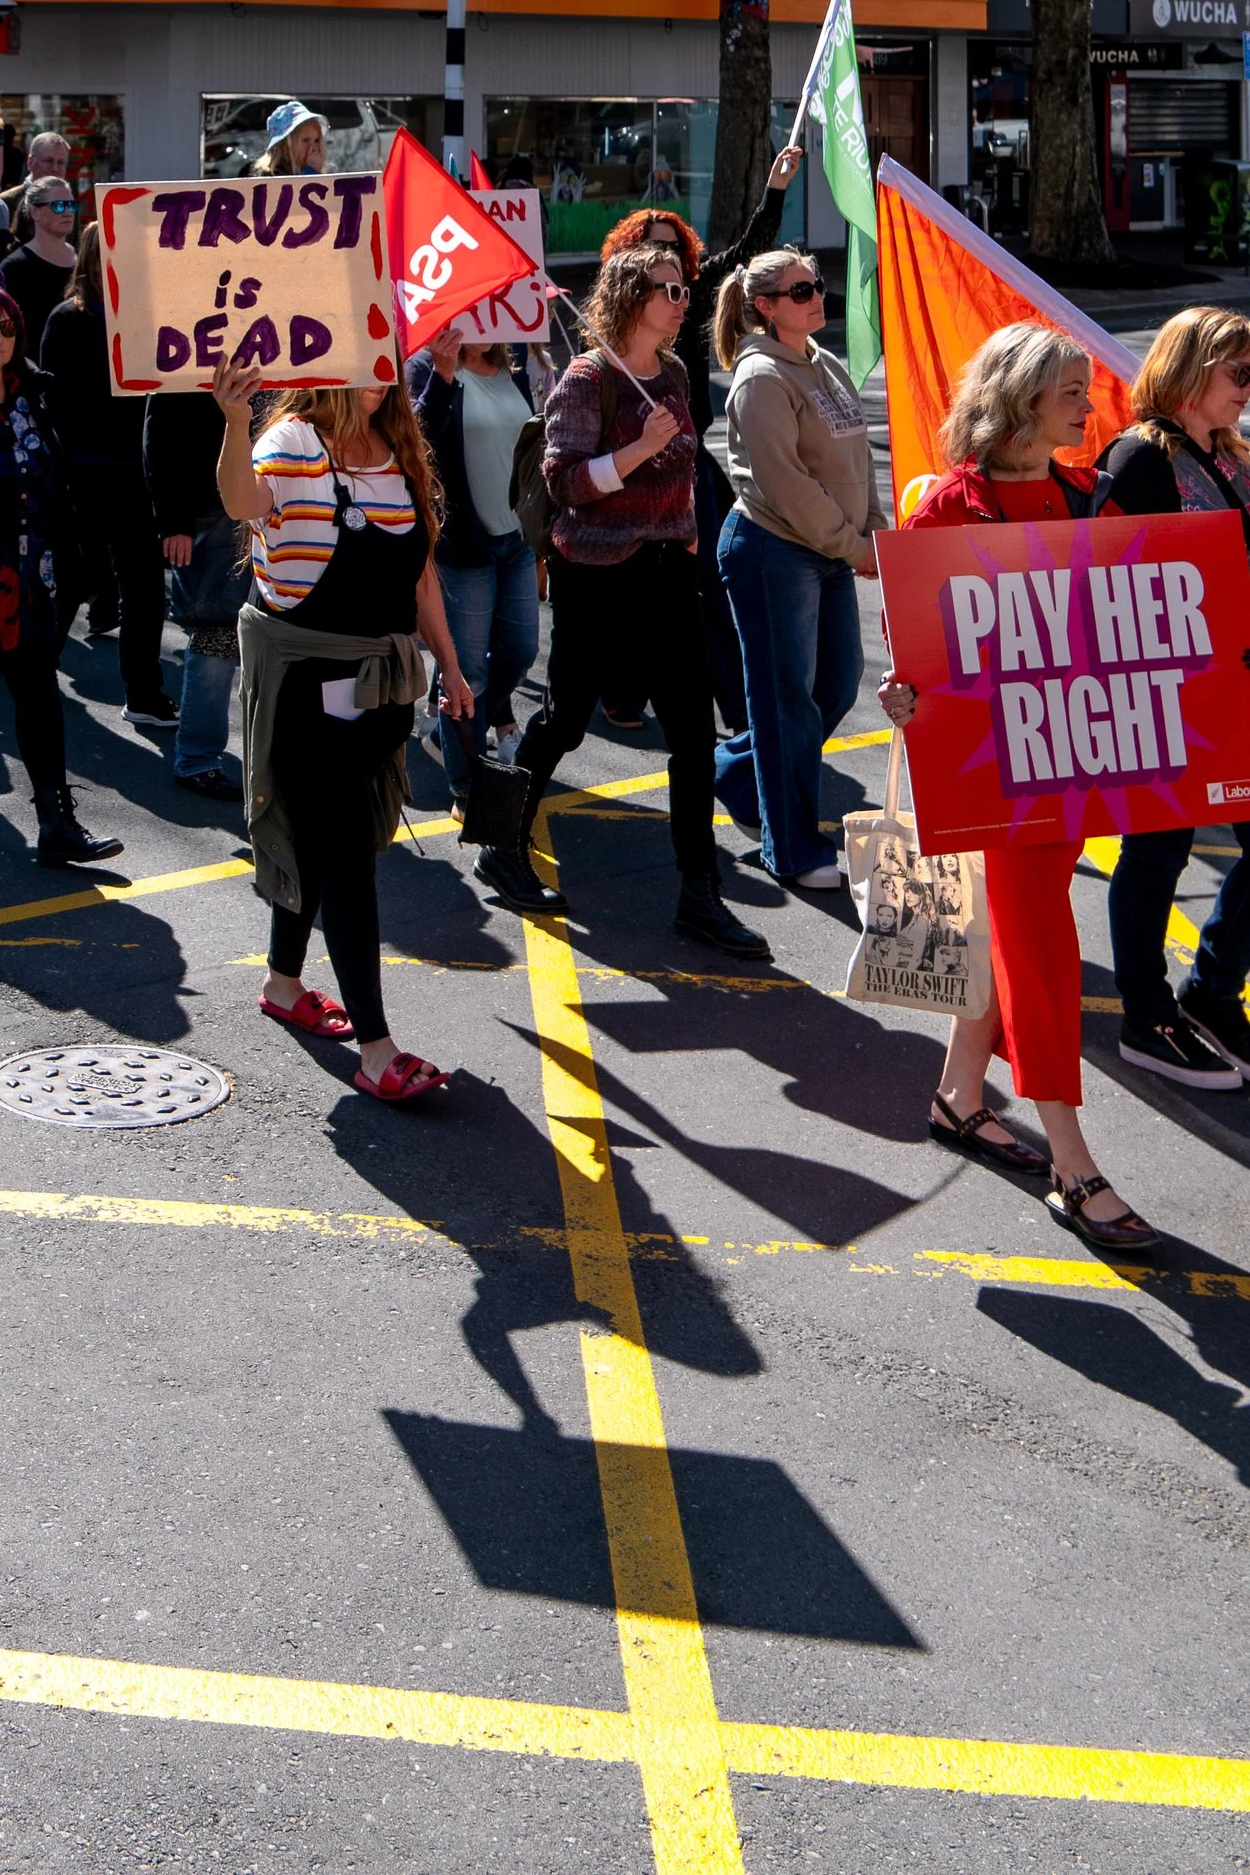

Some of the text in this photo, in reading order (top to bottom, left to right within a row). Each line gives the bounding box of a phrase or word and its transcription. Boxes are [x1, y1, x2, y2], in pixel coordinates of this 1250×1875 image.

[1174, 0, 1237, 25] WUCHA
[152, 176, 376, 250] TRUST
[214, 270, 262, 309] is
[156, 312, 333, 373] DEAD
[950, 561, 1213, 675] PAY HER
[1000, 668, 1188, 783] RIGHT
[865, 963, 968, 997] TAYLOR SWIFT
[865, 982, 967, 1006] THE ERAS TOUR
